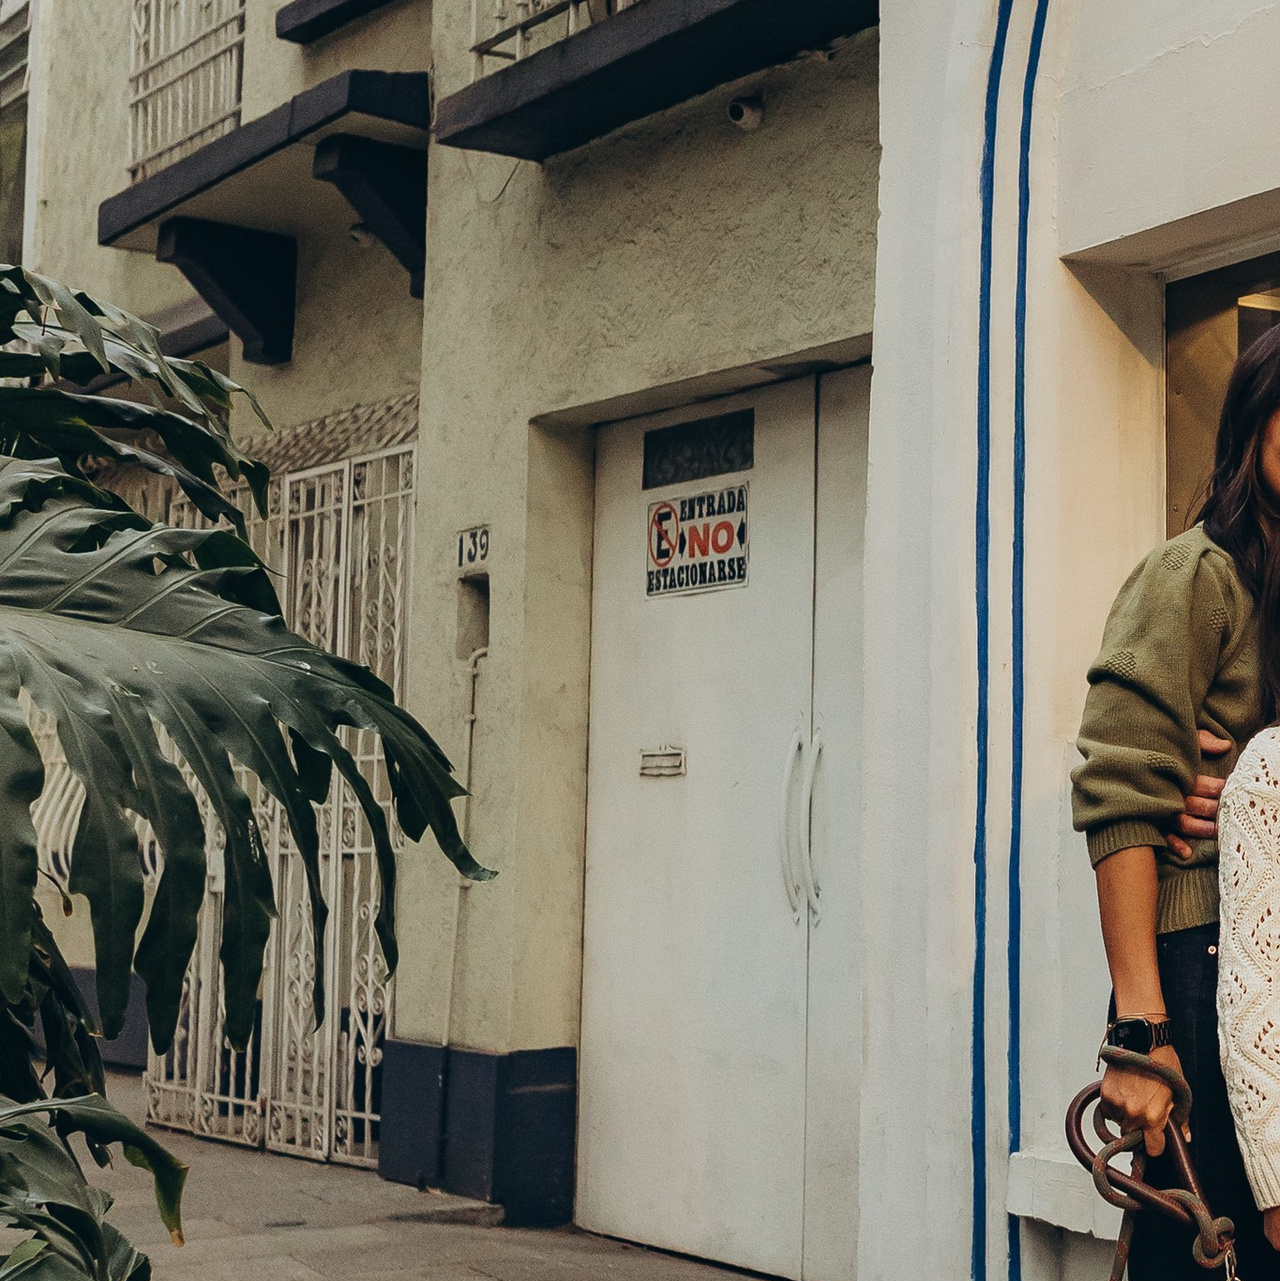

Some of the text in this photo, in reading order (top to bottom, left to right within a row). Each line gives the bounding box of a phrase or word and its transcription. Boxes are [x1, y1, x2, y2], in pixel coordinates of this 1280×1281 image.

[679, 488, 745, 522] ENTRADA
[458, 528, 490, 568] 139
[687, 520, 735, 558] NO
[647, 556, 747, 592] ESTACIONARSE
